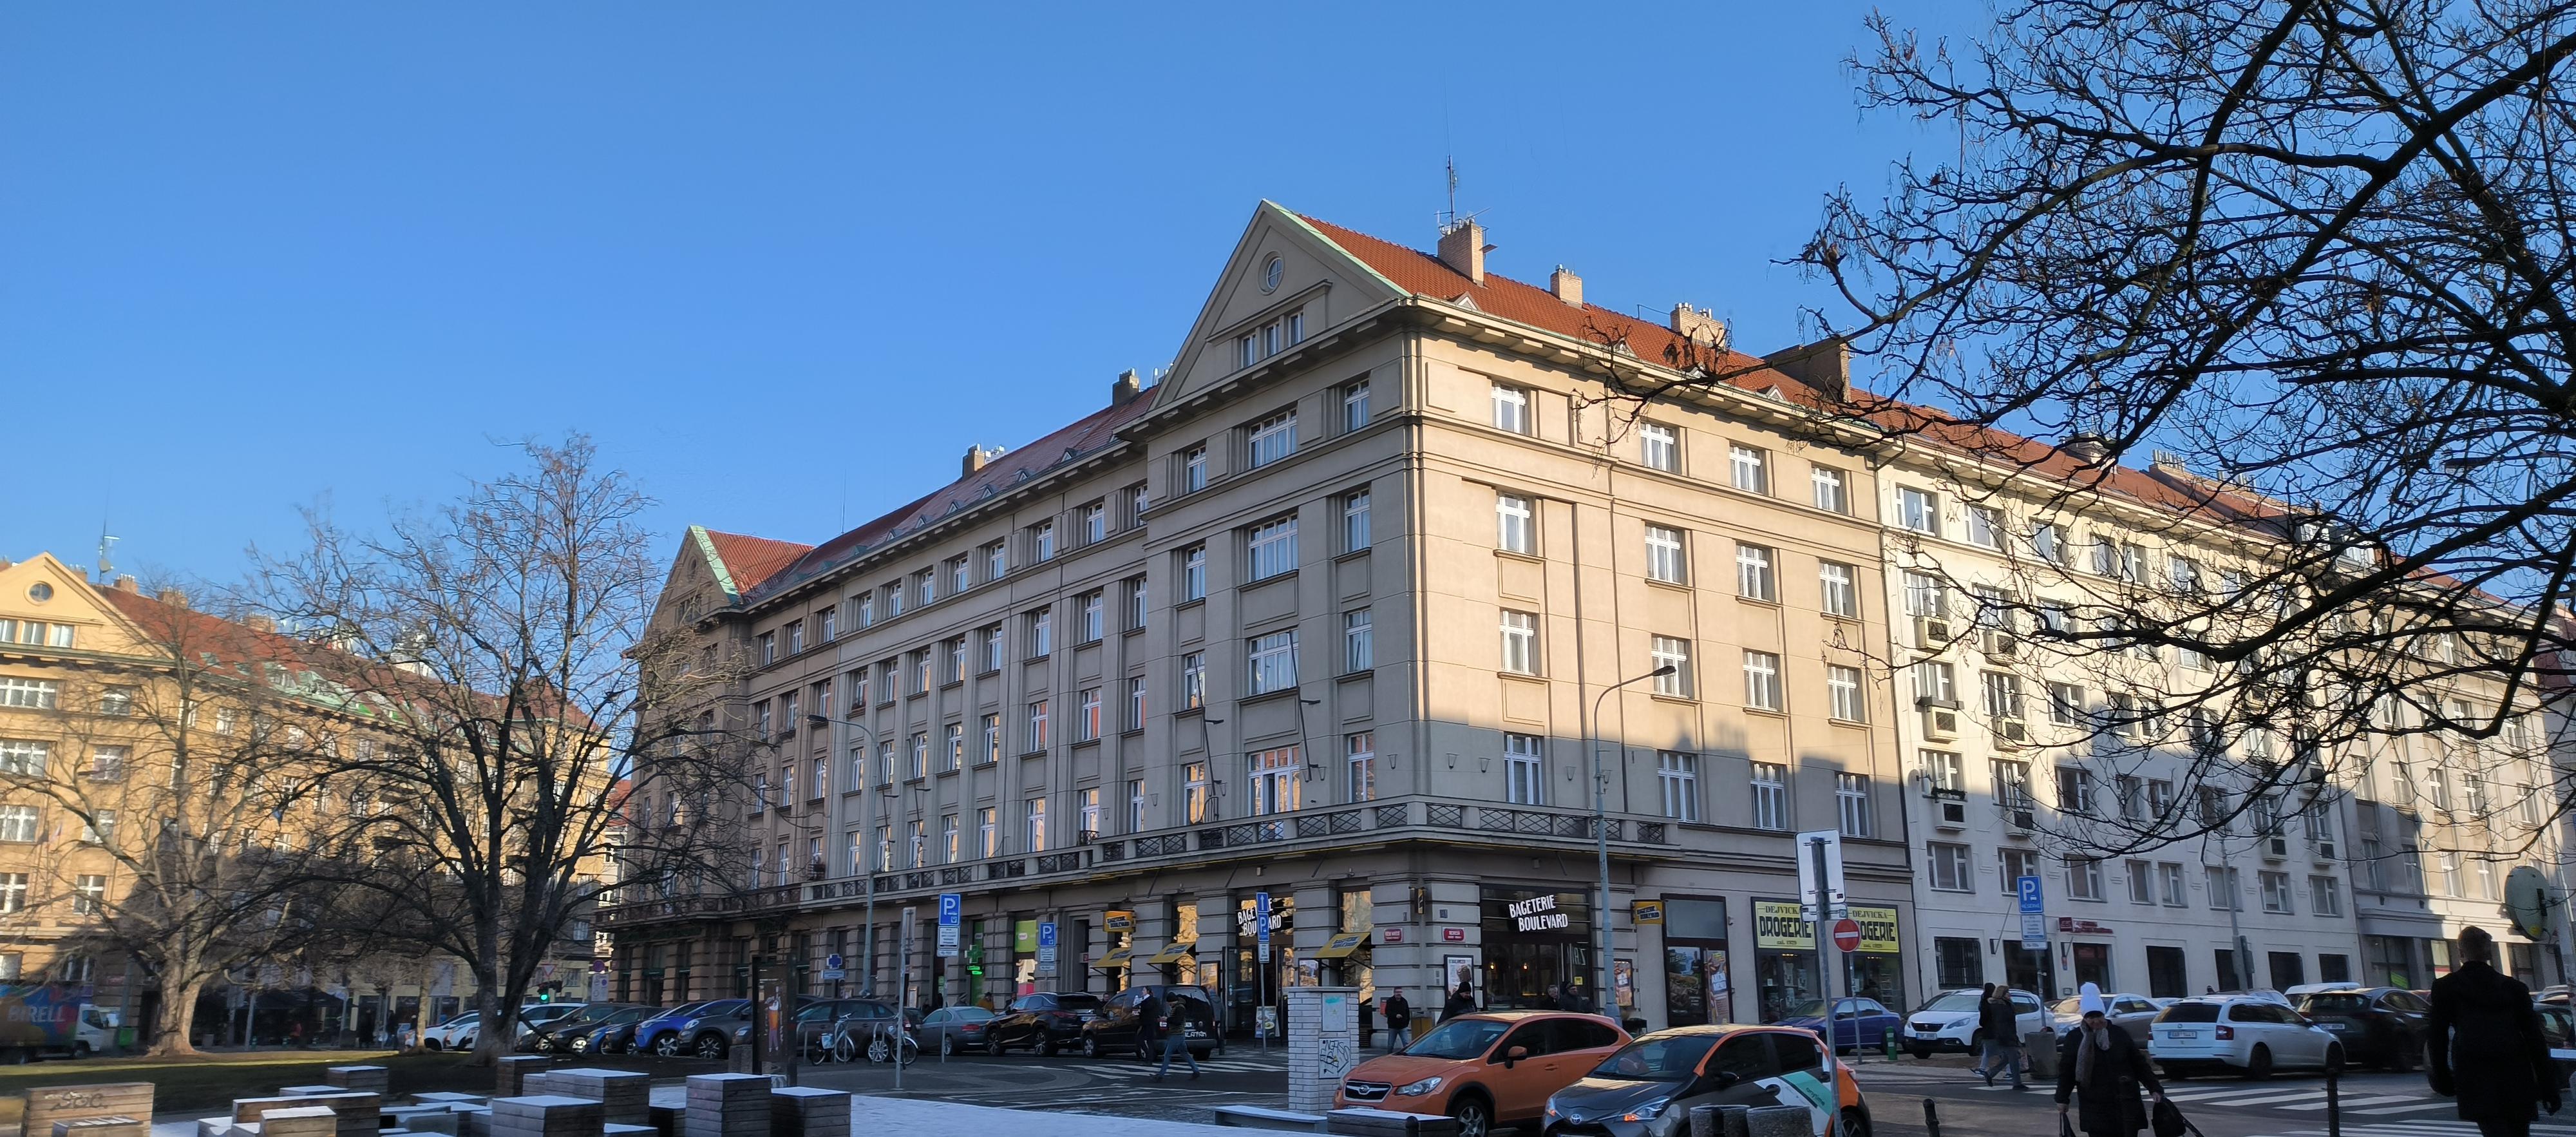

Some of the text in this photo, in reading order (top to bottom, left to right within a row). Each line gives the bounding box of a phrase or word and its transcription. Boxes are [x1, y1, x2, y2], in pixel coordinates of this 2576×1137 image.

[2022, 880, 2036, 901] P
[943, 897, 956, 915] P
[1508, 894, 1556, 918] BAGETERIE
[1765, 905, 1799, 915] DEJVICK
[1043, 926, 1052, 939] P
[1241, 915, 1282, 937] BOUARD
[1518, 913, 1568, 932] BOULEVARD
[1759, 915, 1812, 939] DROGERIE
[1855, 920, 1896, 942] OGERIE
[7, 1004, 64, 1023] BIRELL
